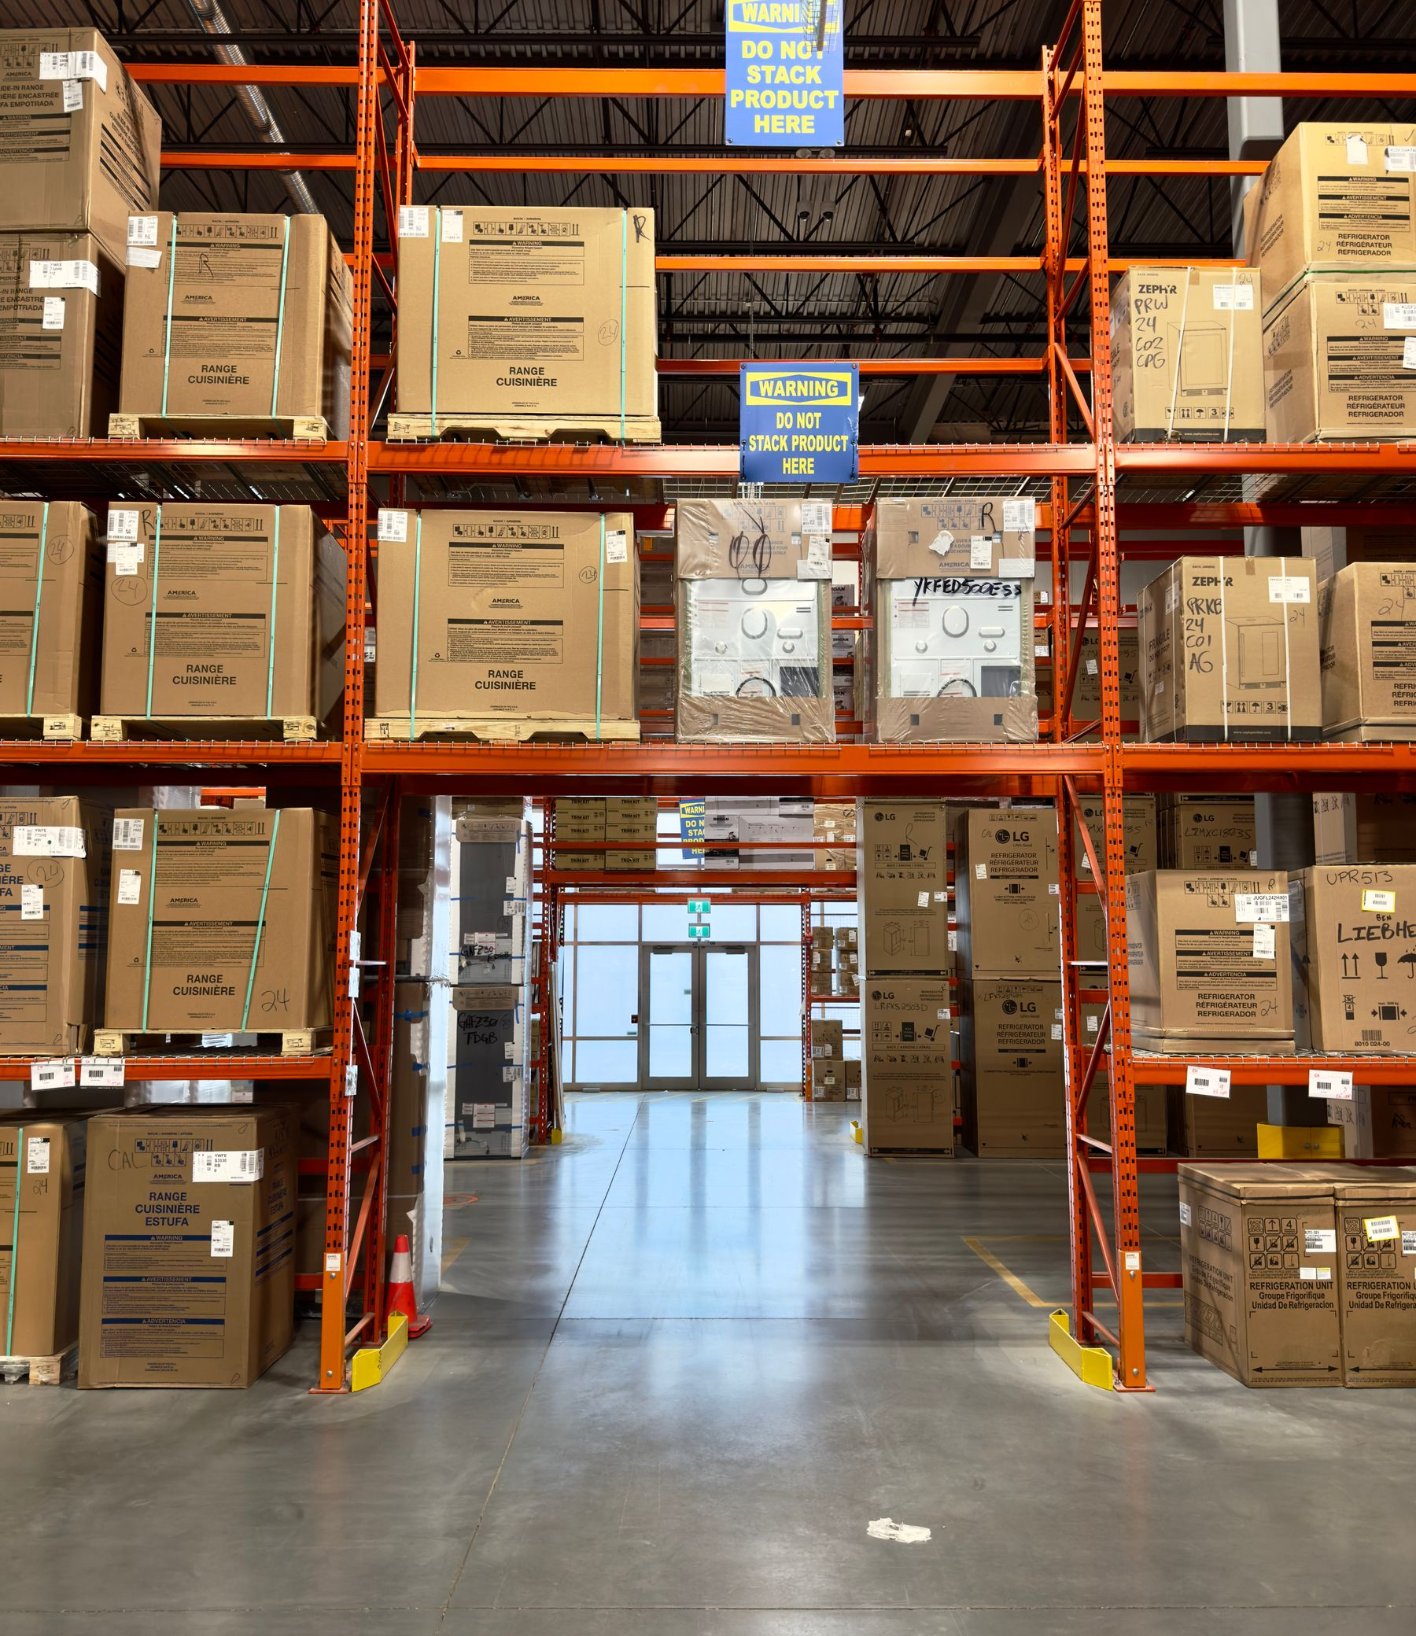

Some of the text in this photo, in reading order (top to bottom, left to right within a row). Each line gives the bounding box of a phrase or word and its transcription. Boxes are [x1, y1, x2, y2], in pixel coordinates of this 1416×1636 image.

[742, 40, 773, 59] DO
[747, 65, 822, 84] STACK
[730, 89, 839, 109] PRODUCT
[754, 115, 816, 134] HERE
[1336, 240, 1392, 248] RÉFRIGÉRATEUR
[1134, 294, 1168, 315] PRW
[1135, 316, 1157, 334] 24
[1136, 352, 1166, 368] CPG
[201, 364, 237, 374] RANGE
[509, 366, 545, 376] RANGE
[188, 374, 250, 384] CUISINIÈRE
[496, 375, 558, 388] CUISINIÈRE
[759, 380, 838, 396] WARNING
[1346, 401, 1406, 410] RÉFRIGÉRATEUR
[776, 412, 822, 428] DO NOT
[749, 434, 848, 452] STACK PRODUCT
[782, 458, 814, 474] HERE
[142, 510, 154, 536] R
[982, 502, 996, 532] R
[1186, 618, 1204, 634] 24
[186, 664, 224, 674] RANGE
[1189, 651, 1214, 674] AG
[172, 672, 236, 686] CUISINIÈRE
[488, 670, 524, 680] RANGE
[474, 678, 536, 690] CUISINIÈRE
[1013, 832, 1030, 842] LG
[1326, 868, 1394, 886] UPR513
[186, 974, 224, 984] RANGE
[172, 982, 236, 996] CUISINIÈRE
[260, 988, 290, 1012] 24
[1196, 1000, 1258, 1009] RÉFRIGÉRATEUR
[1020, 1002, 1036, 1012] LG
[1260, 998, 1278, 1017] 24
[108, 1150, 148, 1171] CAL
[150, 1192, 187, 1201] RANGE
[135, 1202, 200, 1214] CUISINIÈRE
[145, 1217, 189, 1226] ESTUFA
[1250, 1282, 1334, 1290] REFRIGERATION UNIT
[1347, 1282, 1411, 1290] REFRIGERATION
[1259, 1292, 1325, 1300] Groupe Frigorifique
[1356, 1292, 1382, 1300] Groupe
[1252, 1301, 1276, 1309] Unidad
[1288, 1301, 1334, 1310] Refrigeracion
[1349, 1301, 1373, 1309] Unidad
